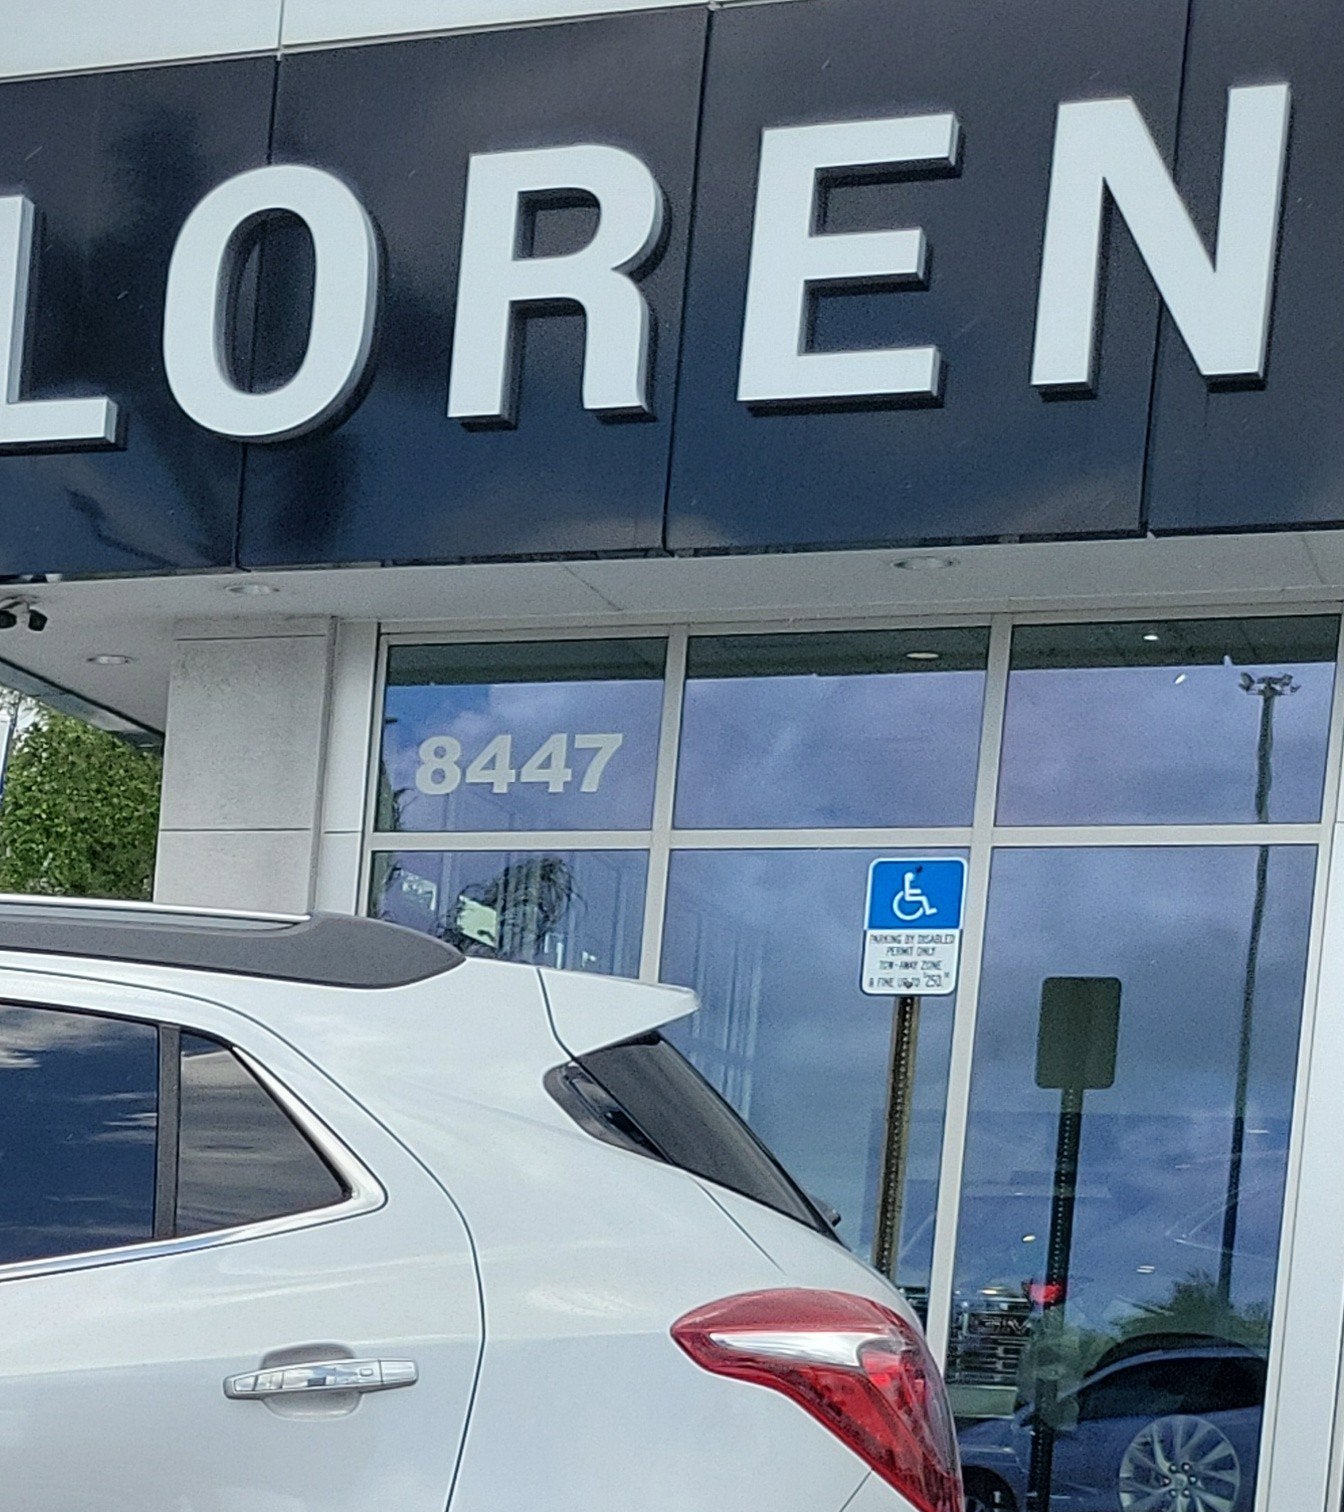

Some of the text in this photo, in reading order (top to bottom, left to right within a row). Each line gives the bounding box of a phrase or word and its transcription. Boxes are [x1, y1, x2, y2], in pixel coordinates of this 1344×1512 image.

[415, 733, 623, 795] 8447
[904, 934, 915, 944] BY
[916, 947, 936, 956] ONLY
[920, 960, 943, 970] ZONE
